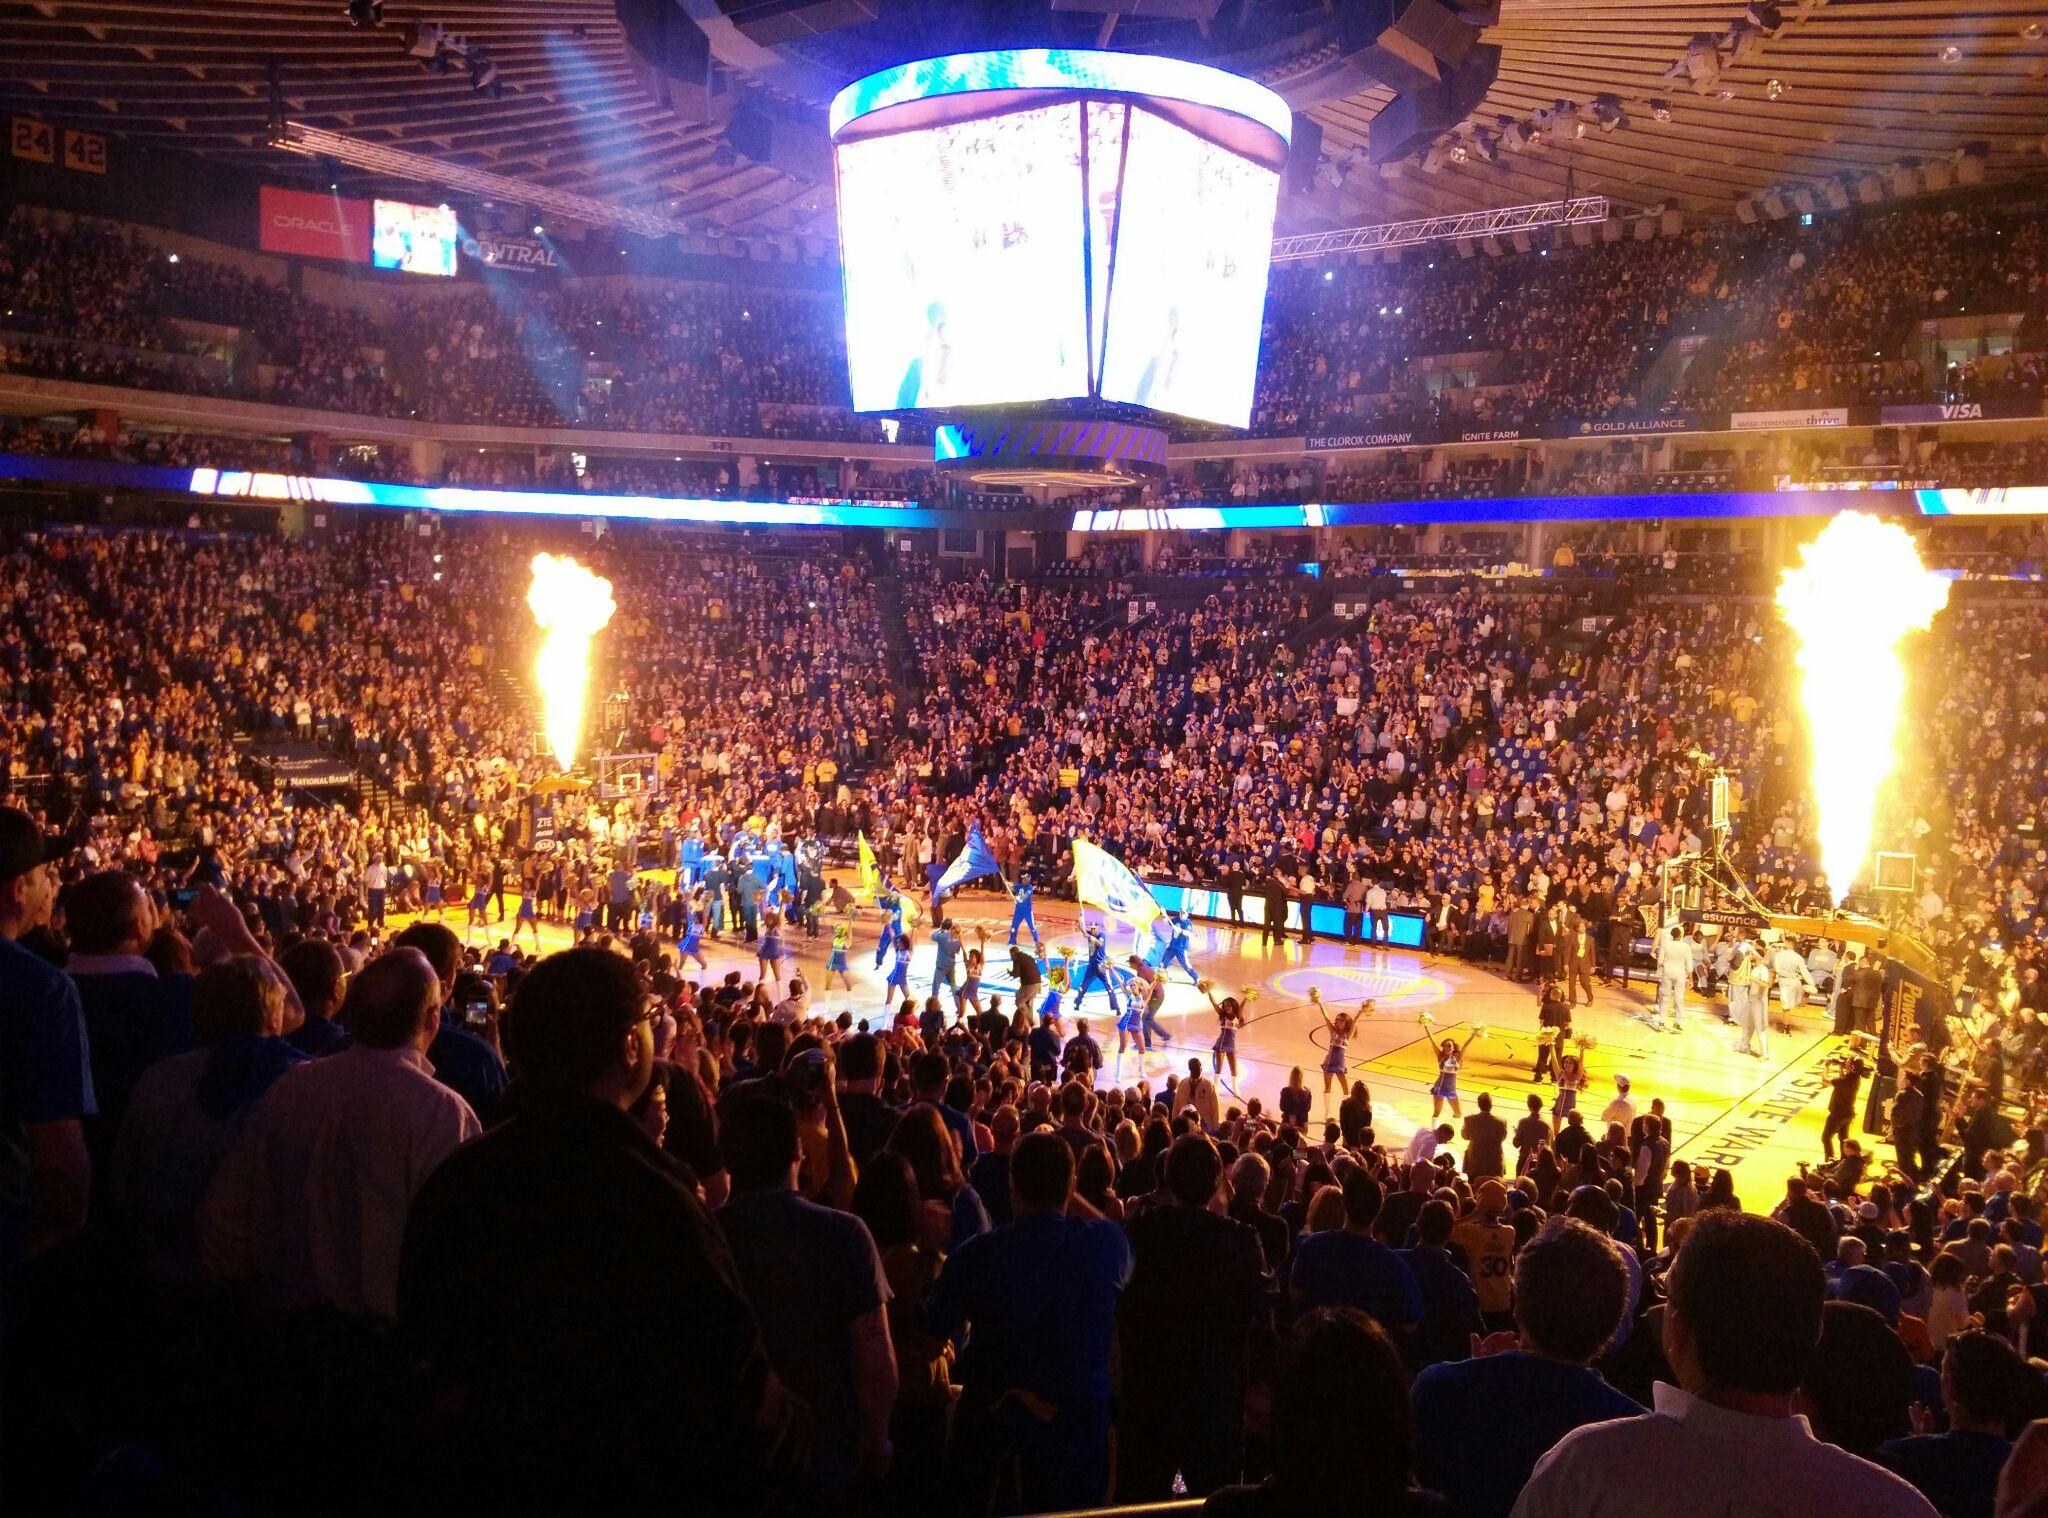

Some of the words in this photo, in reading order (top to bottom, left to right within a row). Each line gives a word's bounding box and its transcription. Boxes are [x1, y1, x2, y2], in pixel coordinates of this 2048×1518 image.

[16, 123, 51, 155] 24
[69, 135, 103, 167] 42
[273, 215, 353, 236] ORACLE
[1939, 403, 1983, 419] VISA
[1593, 422, 1626, 432] GOLD
[1627, 420, 1686, 430] ALLIANCE
[1806, 414, 1840, 426] thrive
[1309, 438, 1326, 448] THE
[1327, 435, 1364, 447] CLOROX
[1365, 433, 1412, 445] COMPANY
[1461, 432, 1491, 442] IGNITE
[1493, 430, 1519, 440] FARM
[290, 776, 328, 786] NATIONAL
[536, 816, 553, 829] ZTE
[1702, 912, 1758, 926] esurance
[1748, 1078, 1827, 1125] STATE
[1480, 1256, 1509, 1279] 30
